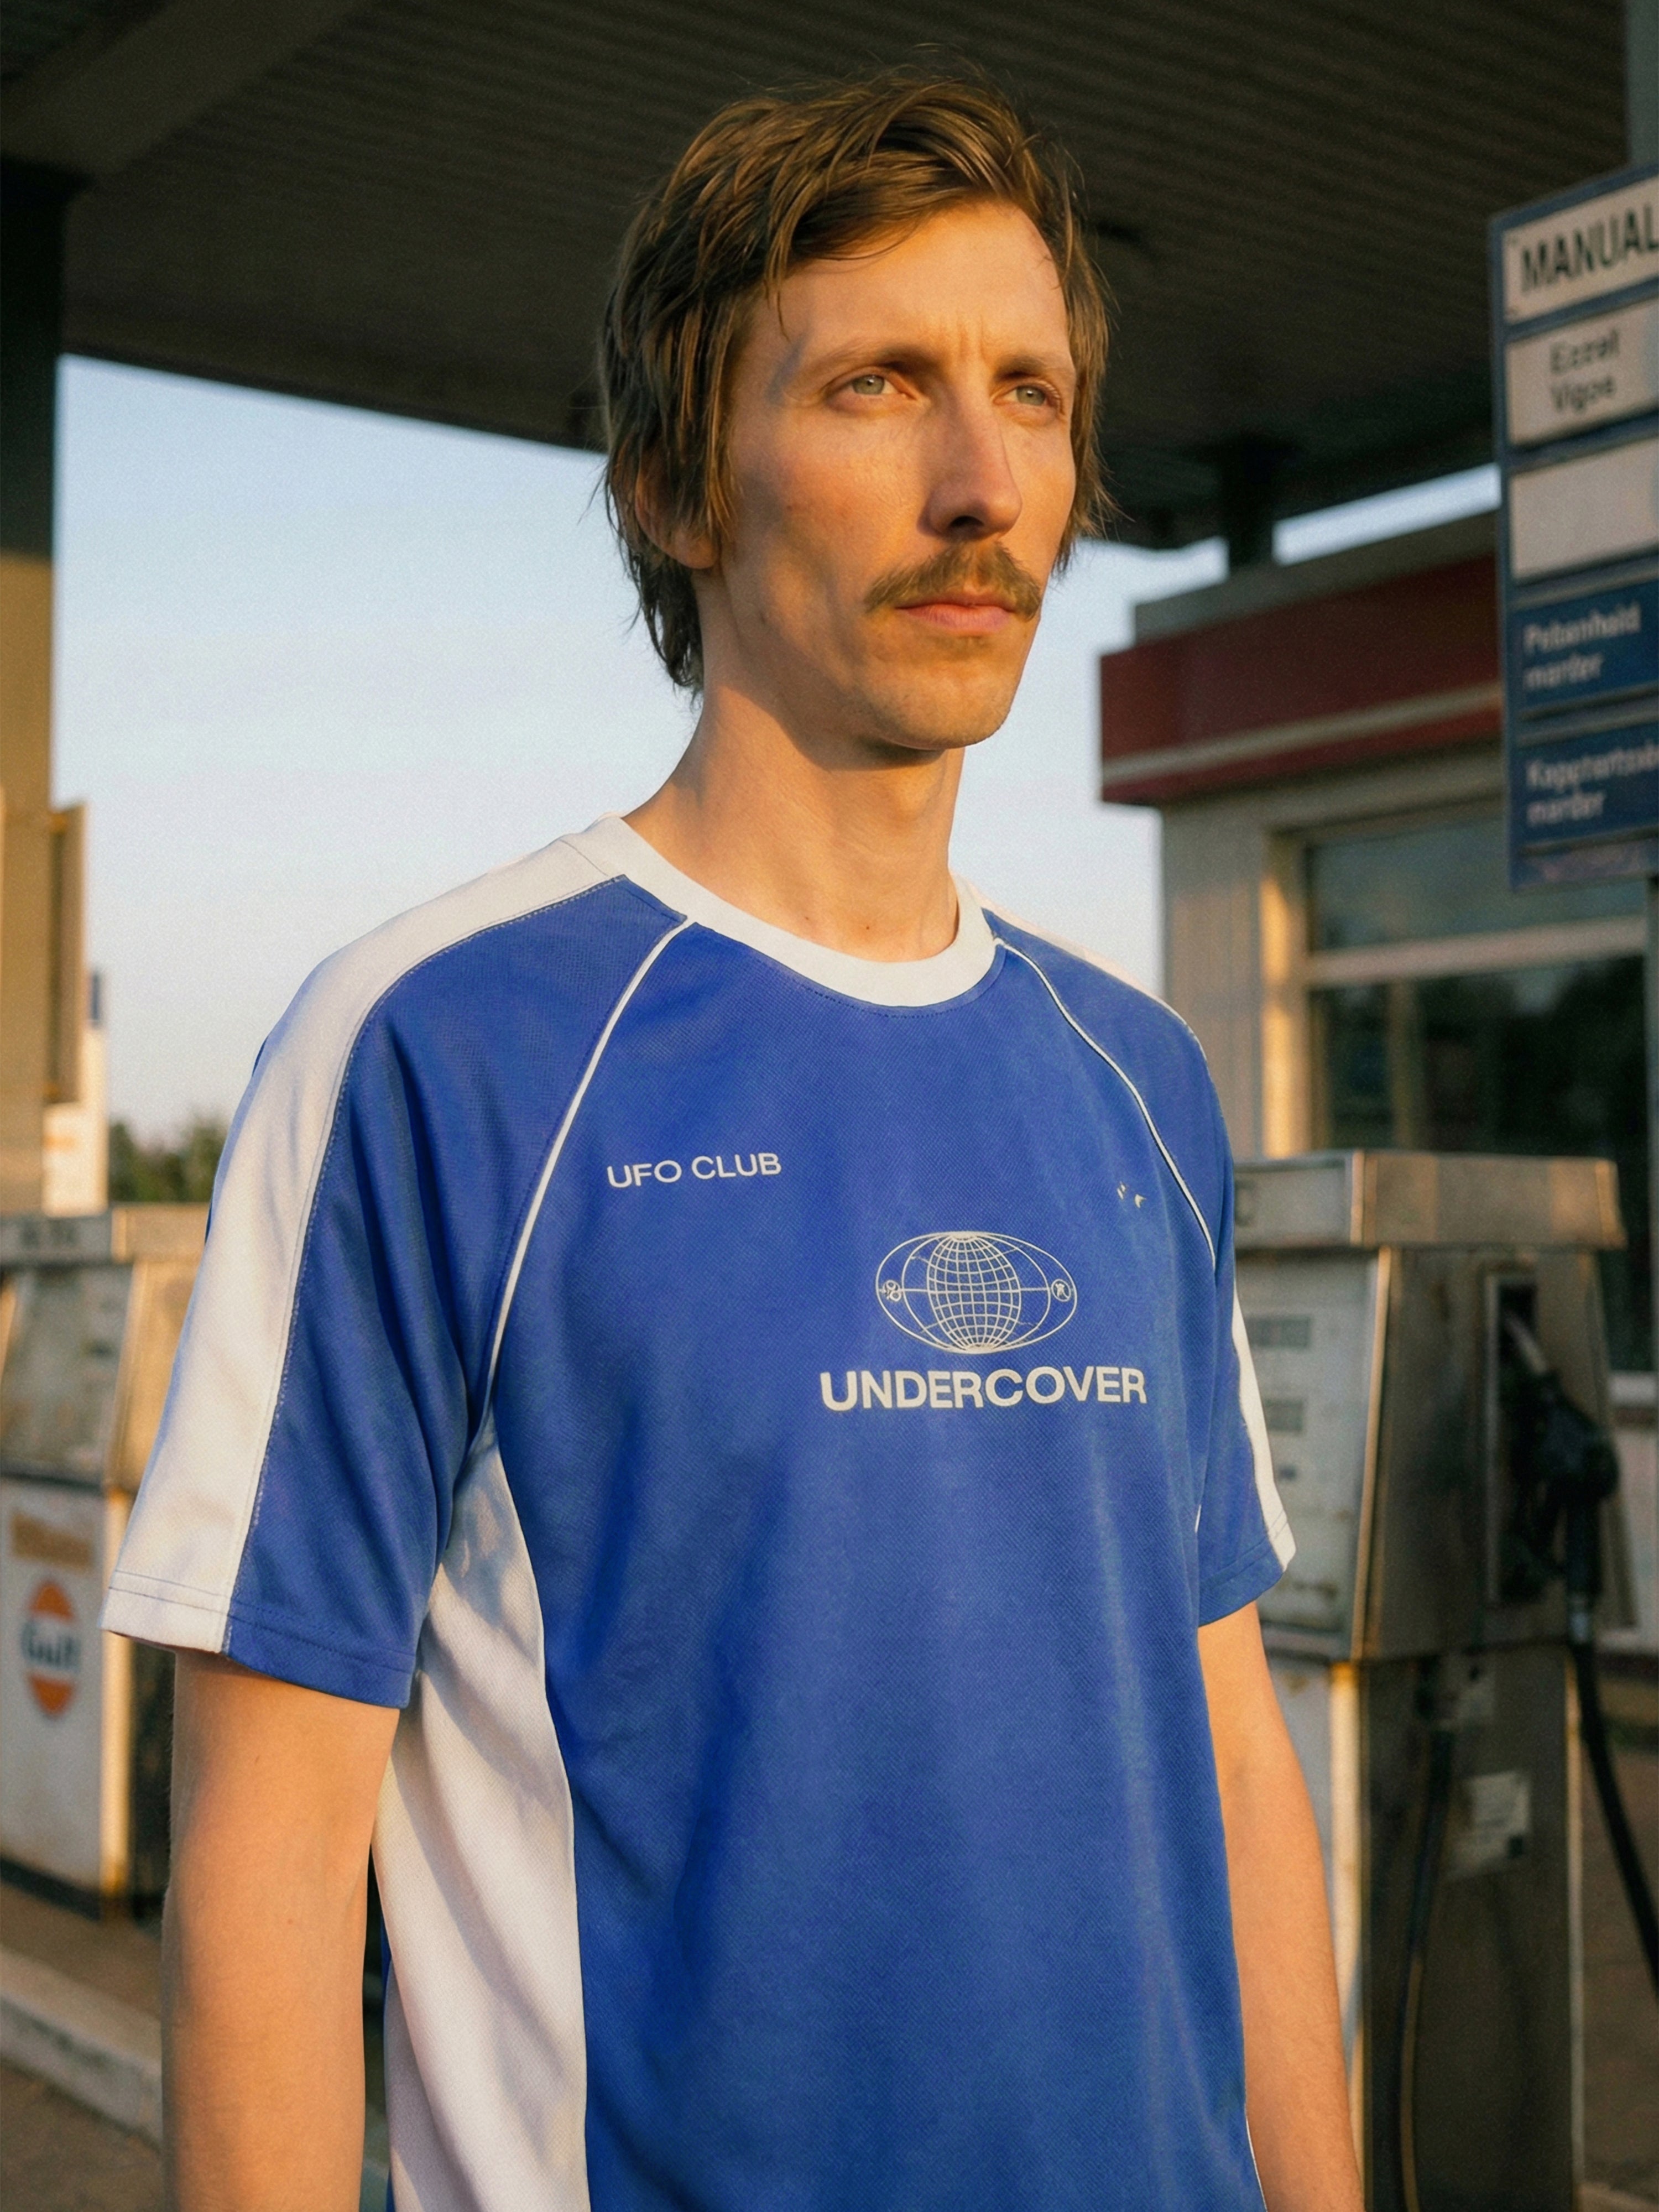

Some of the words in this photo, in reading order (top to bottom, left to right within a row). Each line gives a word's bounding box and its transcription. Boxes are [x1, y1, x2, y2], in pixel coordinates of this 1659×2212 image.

[1522, 204, 1659, 293] MANUAL
[607, 1160, 682, 1188] UFO
[691, 1152, 781, 1179] CLUB
[820, 1366, 1147, 1411] UNDERCOVER
